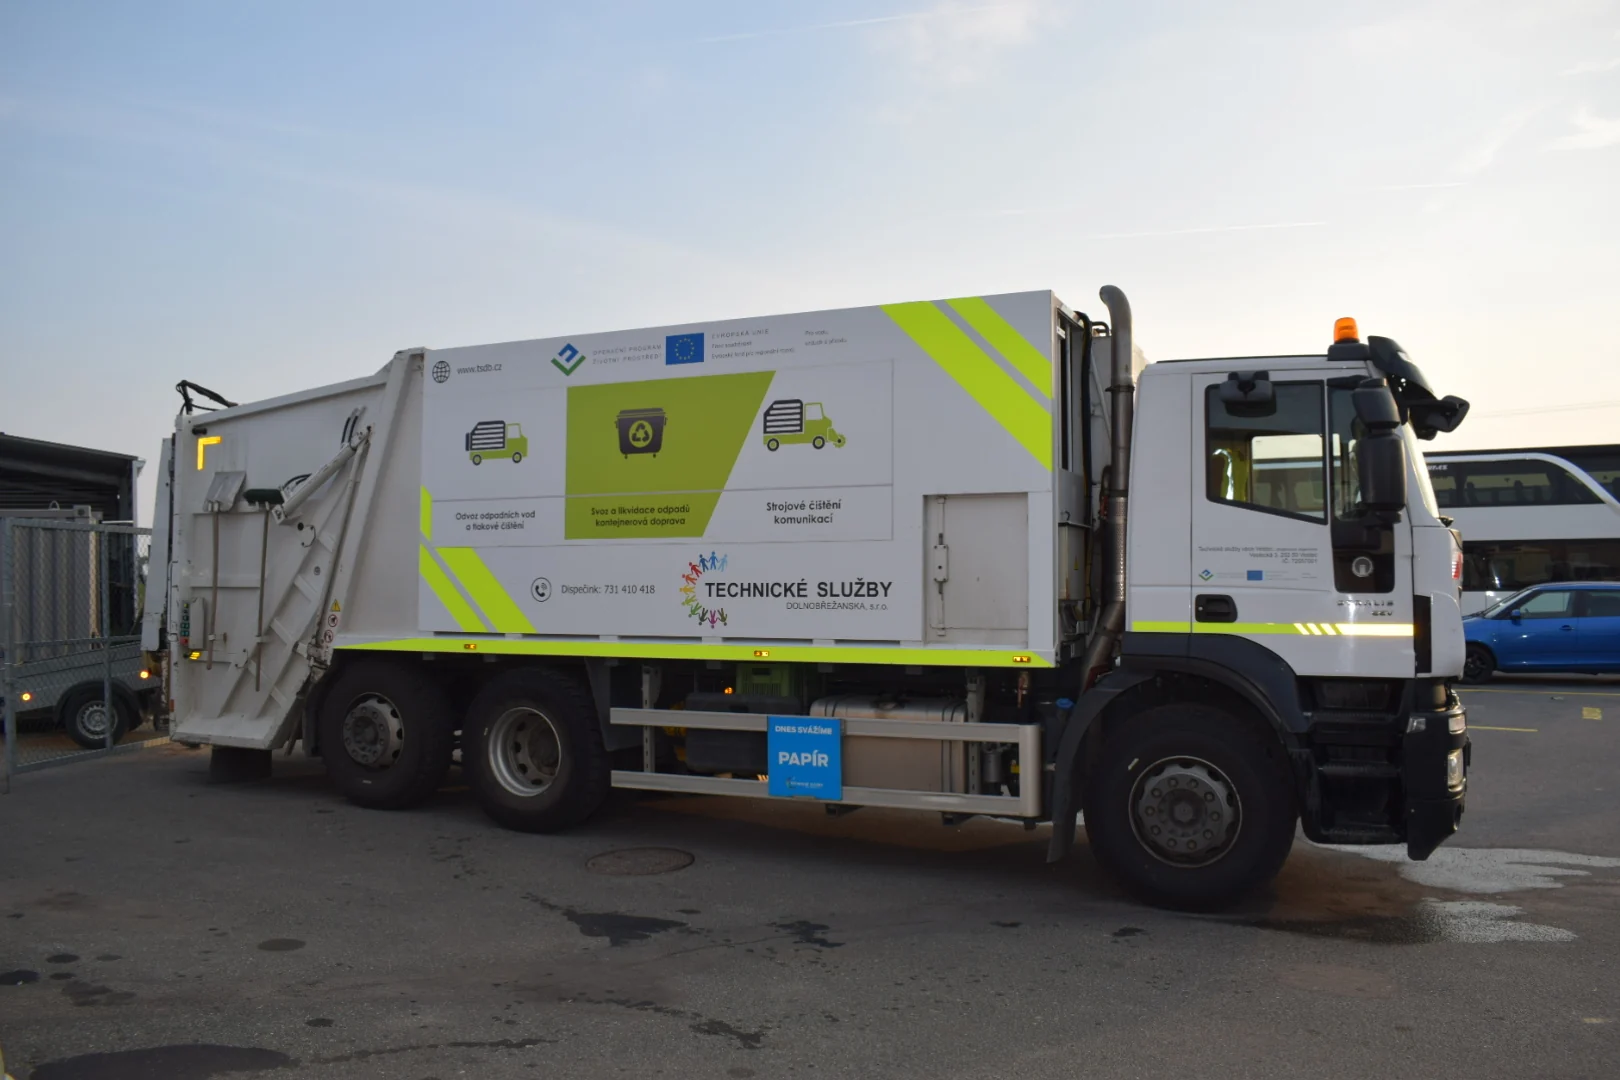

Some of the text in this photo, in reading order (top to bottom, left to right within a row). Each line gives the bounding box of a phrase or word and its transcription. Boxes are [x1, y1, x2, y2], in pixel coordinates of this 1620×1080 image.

[457, 363, 502, 375] www.tsdb.cz
[591, 507, 609, 516] Svoz
[618, 506, 655, 515] likvidace
[657, 504, 690, 515] odpadů
[766, 498, 842, 513] Strojové čištění
[455, 510, 536, 521] Odvoz odpadních vod
[774, 512, 834, 524] komunikací
[465, 523, 471, 531] a
[500, 520, 525, 530] čištění
[595, 516, 686, 528] kontejnerová doprava
[561, 584, 656, 595] Dispečink: 731 410 418
[705, 577, 893, 598] TECHNICKÉ SLUŽBY
[786, 600, 888, 611] DOLNOBŘEŽANSKA, s.r.o.
[775, 725, 833, 735] DNES SVÁŽÍME
[778, 749, 829, 767] PAPÍR
